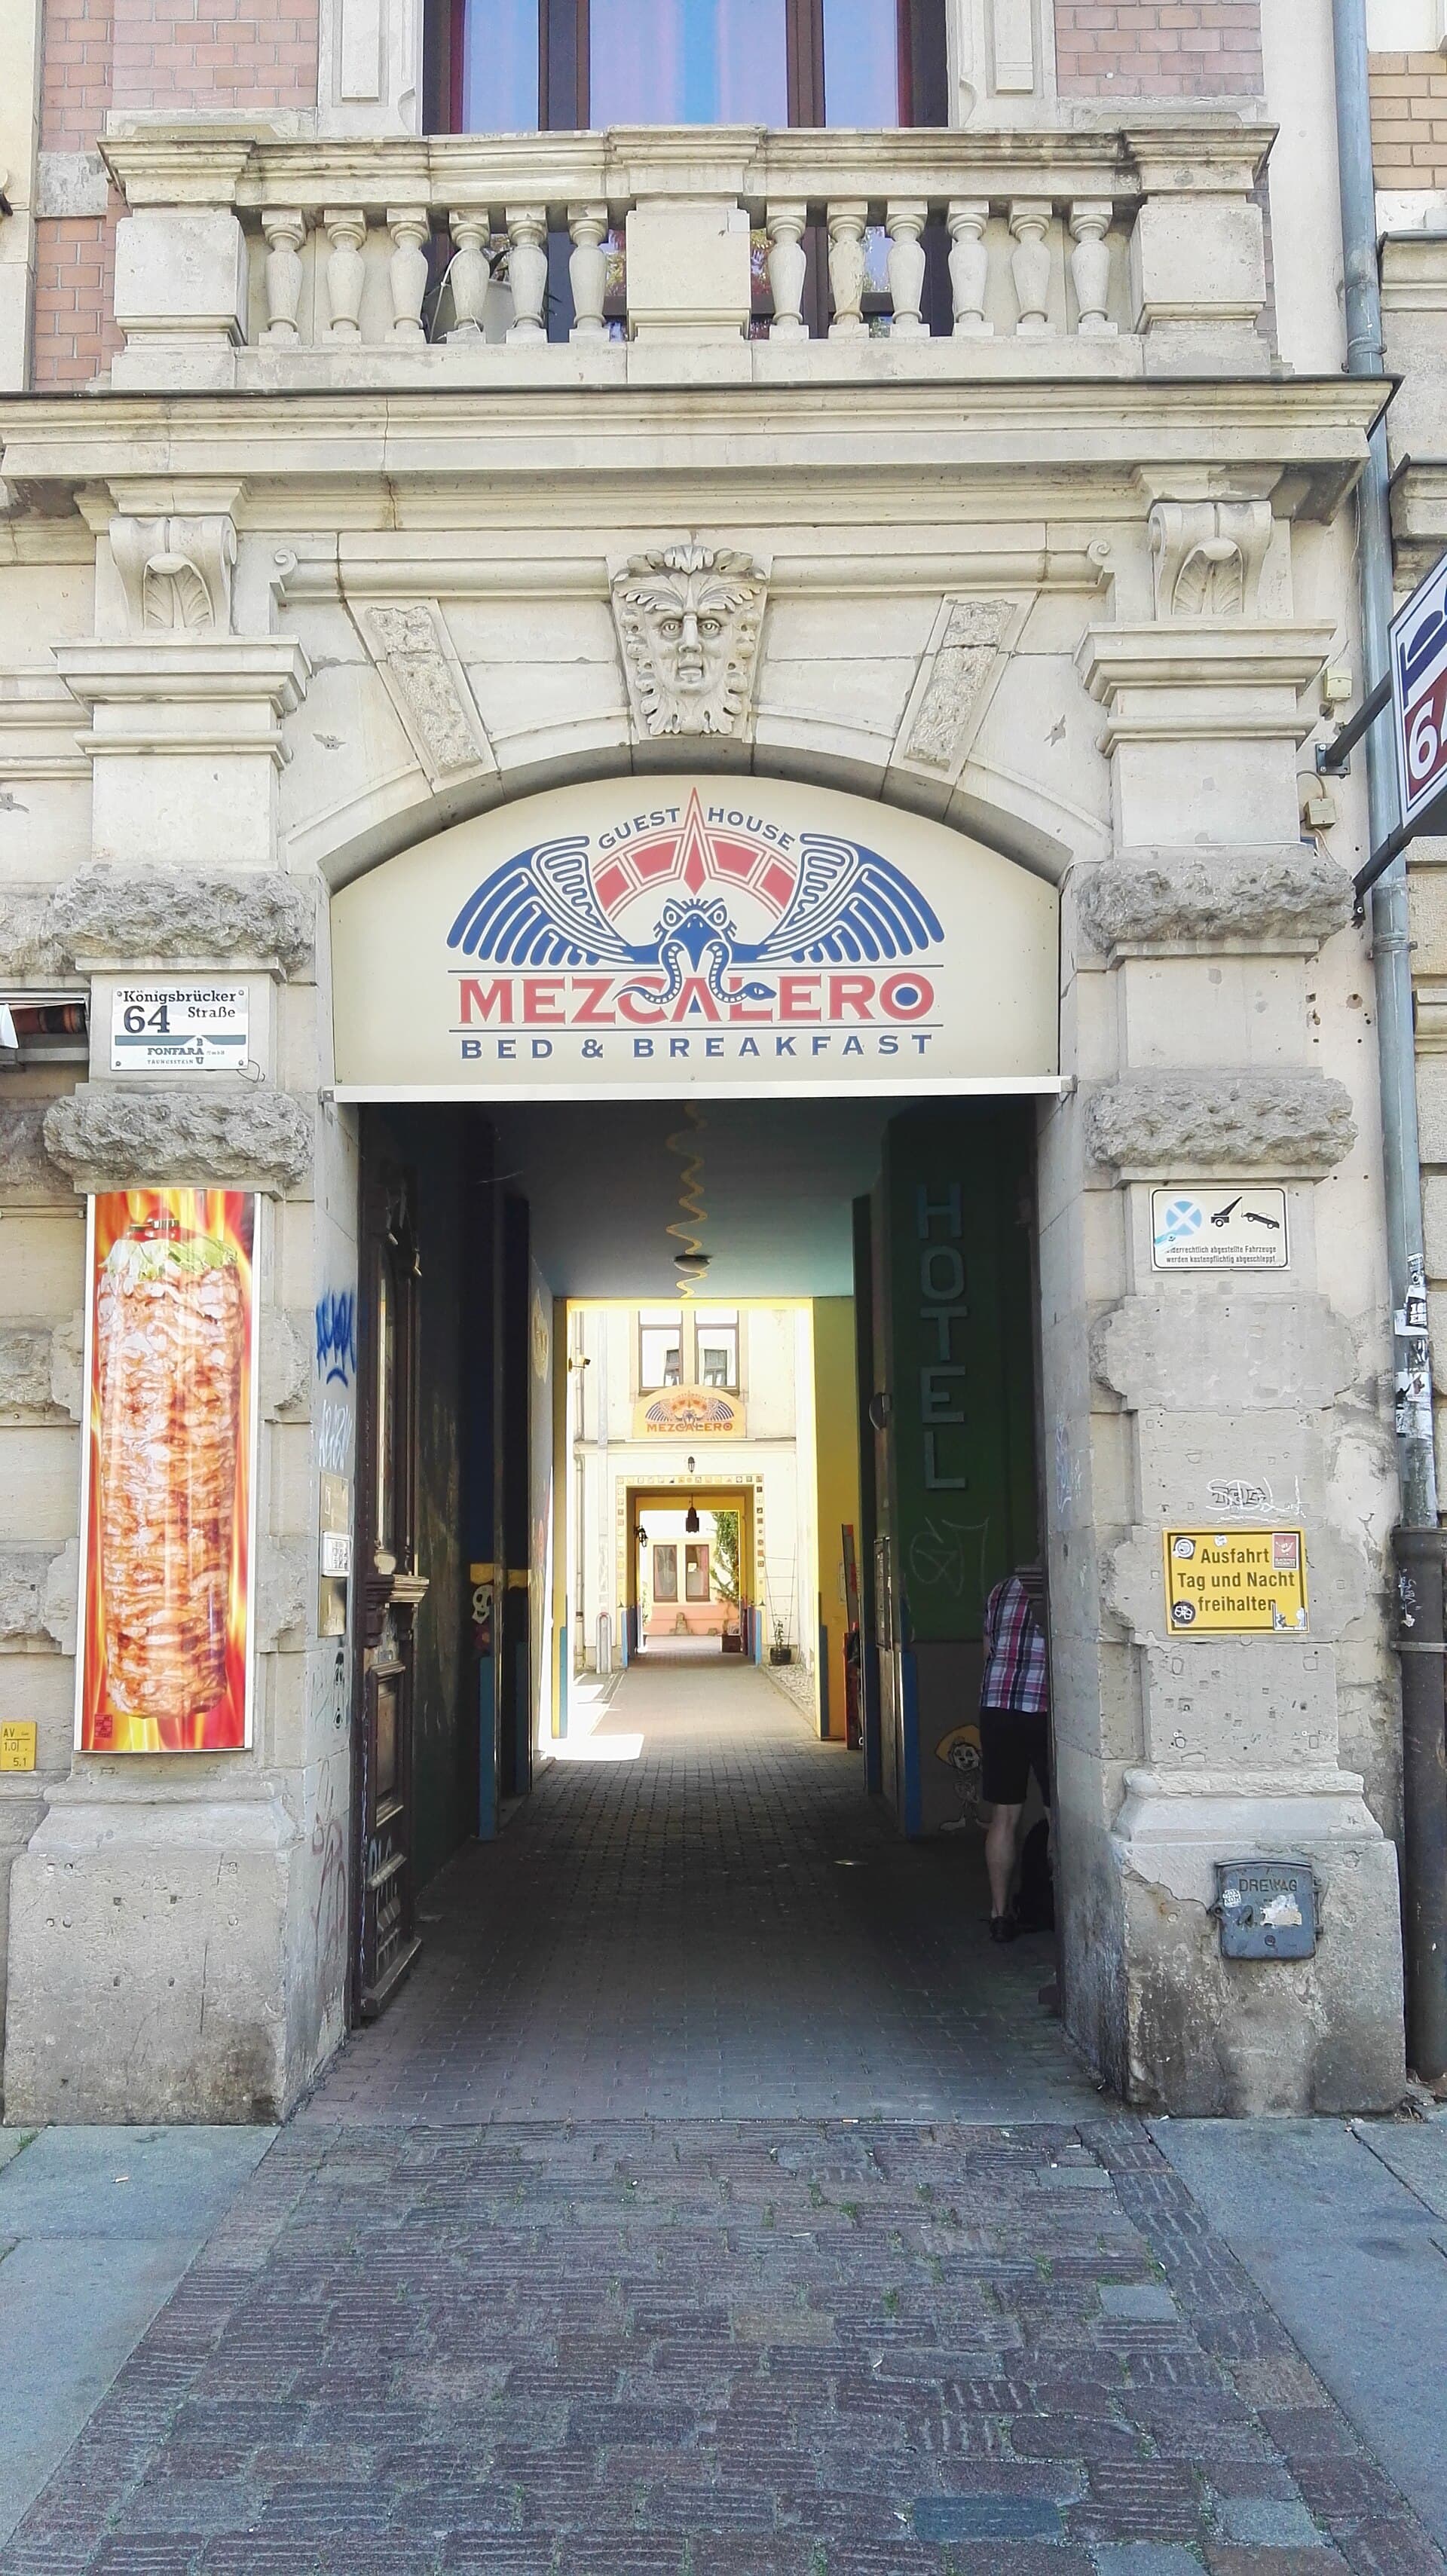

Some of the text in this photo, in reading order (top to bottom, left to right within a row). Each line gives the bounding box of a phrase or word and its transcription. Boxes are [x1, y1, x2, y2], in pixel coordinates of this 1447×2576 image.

[598, 807, 796, 851] GUEST HOUSE
[123, 990, 237, 1004] Königsbrücker
[458, 972, 935, 1025] MEZCALERO
[124, 1005, 170, 1034] 64
[188, 1006, 236, 1018] Straße
[460, 1033, 934, 1059] BED & BREAKFAST
[1245, 1245, 1277, 1254] Fahrzeuge
[1190, 1255, 1234, 1264] kostenpflichtig
[1236, 1254, 1276, 1264] abgeschleppt
[916, 1182, 968, 1490] HOTEL
[647, 1422, 733, 1433] MEZCALERO
[1201, 1548, 1270, 1564] Ausfahrt
[1177, 1572, 1296, 1590] Tag und Nacht
[1198, 1597, 1277, 1612] freihalten
[13, 1757, 26, 1767] 5.1
[1239, 1878, 1298, 1892] DREWAG
